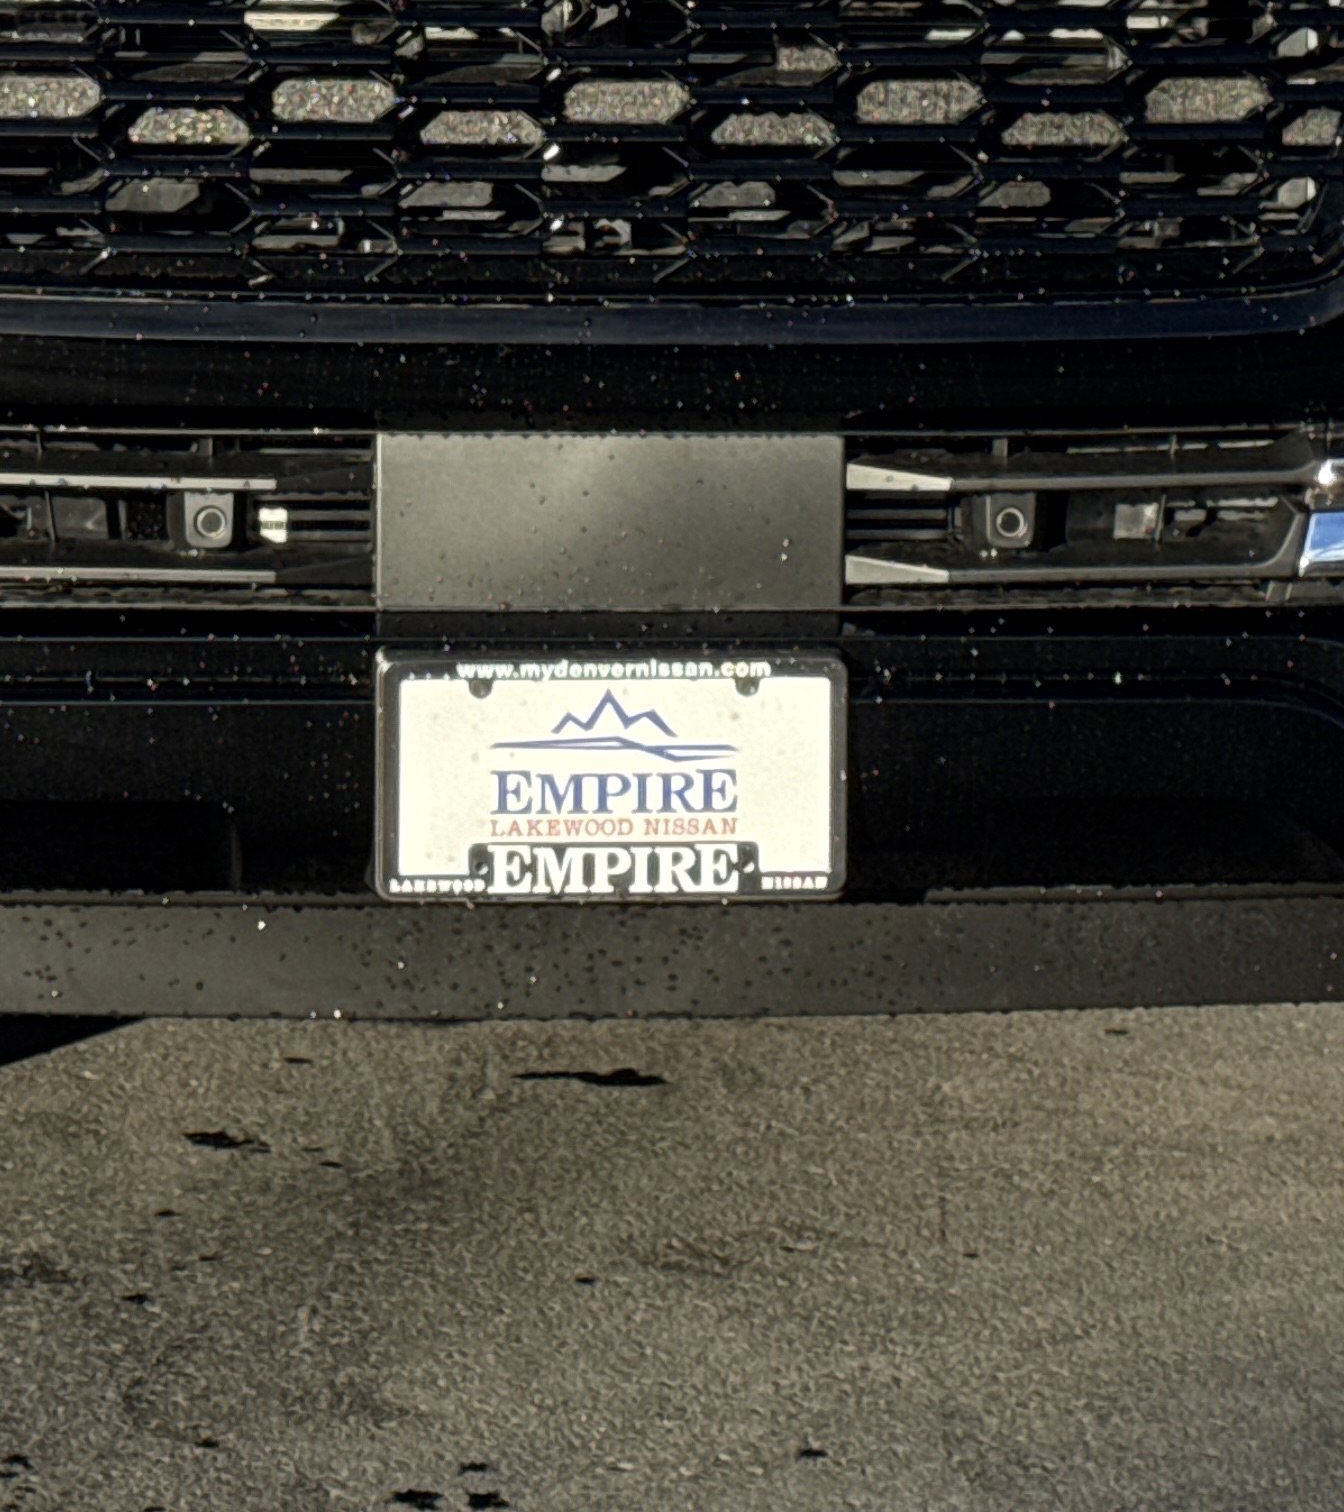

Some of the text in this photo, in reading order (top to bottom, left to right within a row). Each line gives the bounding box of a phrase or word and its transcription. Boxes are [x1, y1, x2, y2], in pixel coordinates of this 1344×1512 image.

[489, 768, 738, 815] EMPIRE
[489, 816, 739, 838] LAKEWOOD NISSAN
[487, 843, 739, 893] EMPIRE
